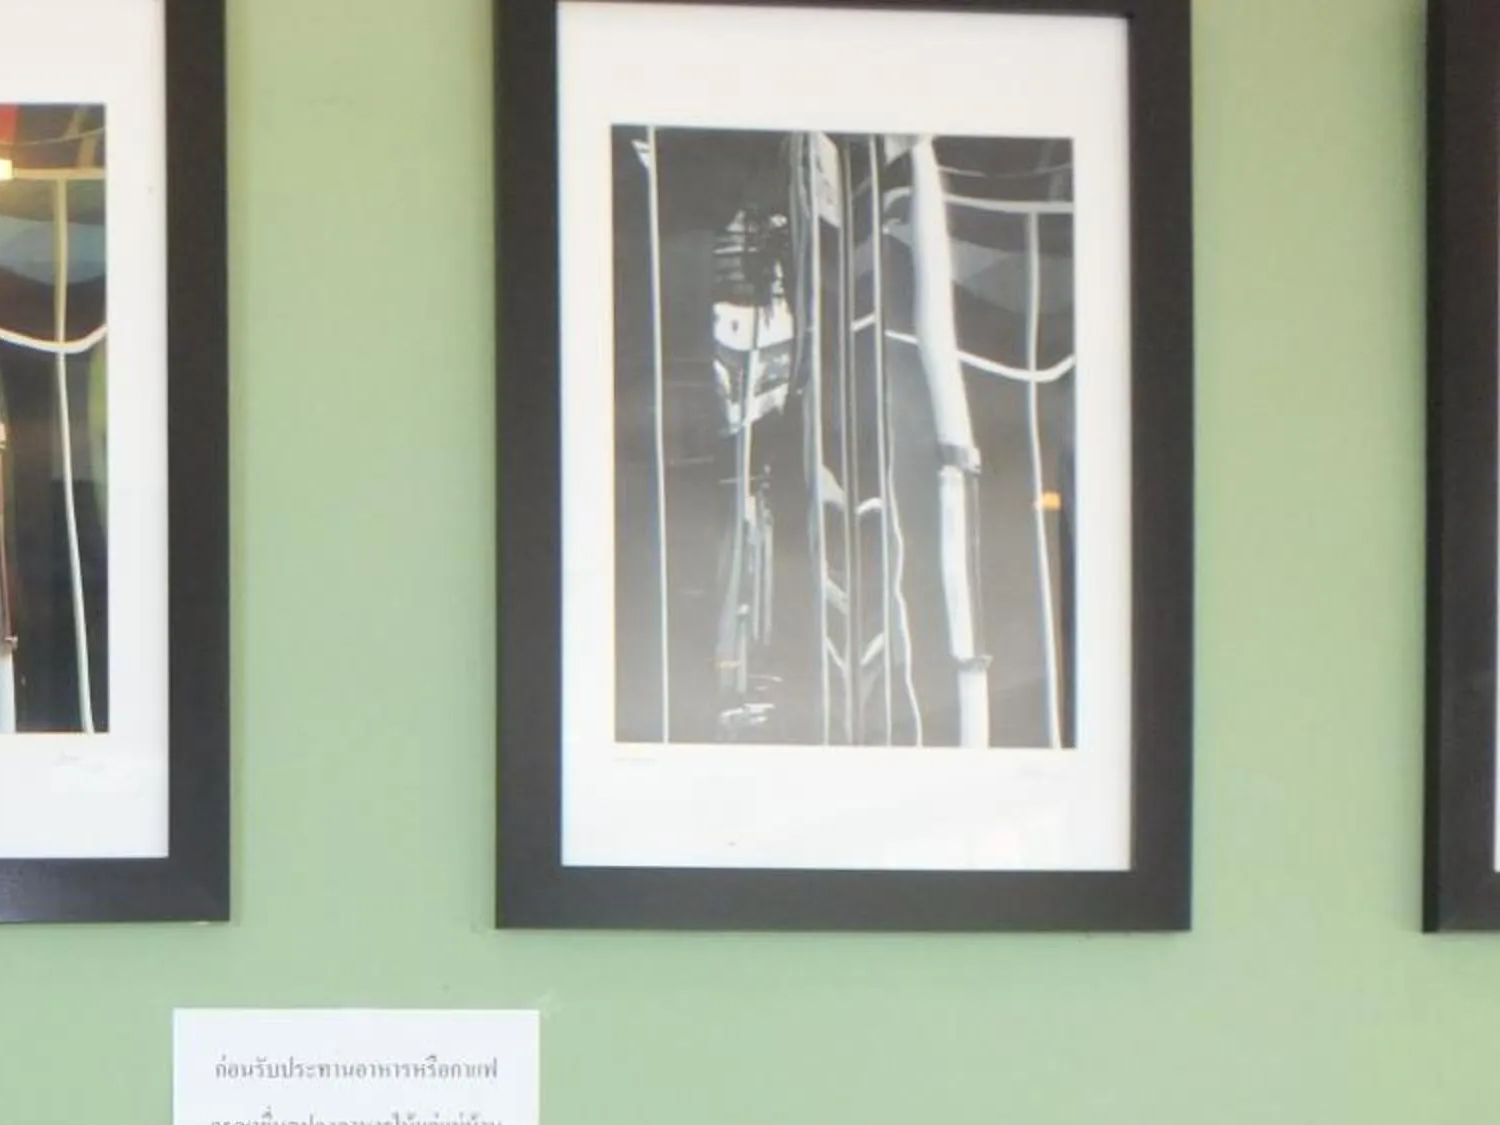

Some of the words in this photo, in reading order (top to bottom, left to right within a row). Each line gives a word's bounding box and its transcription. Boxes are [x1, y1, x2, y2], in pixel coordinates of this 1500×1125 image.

[214, 1053, 498, 1079] ก่อนรับประทานอาหารหรือกาแฟ
